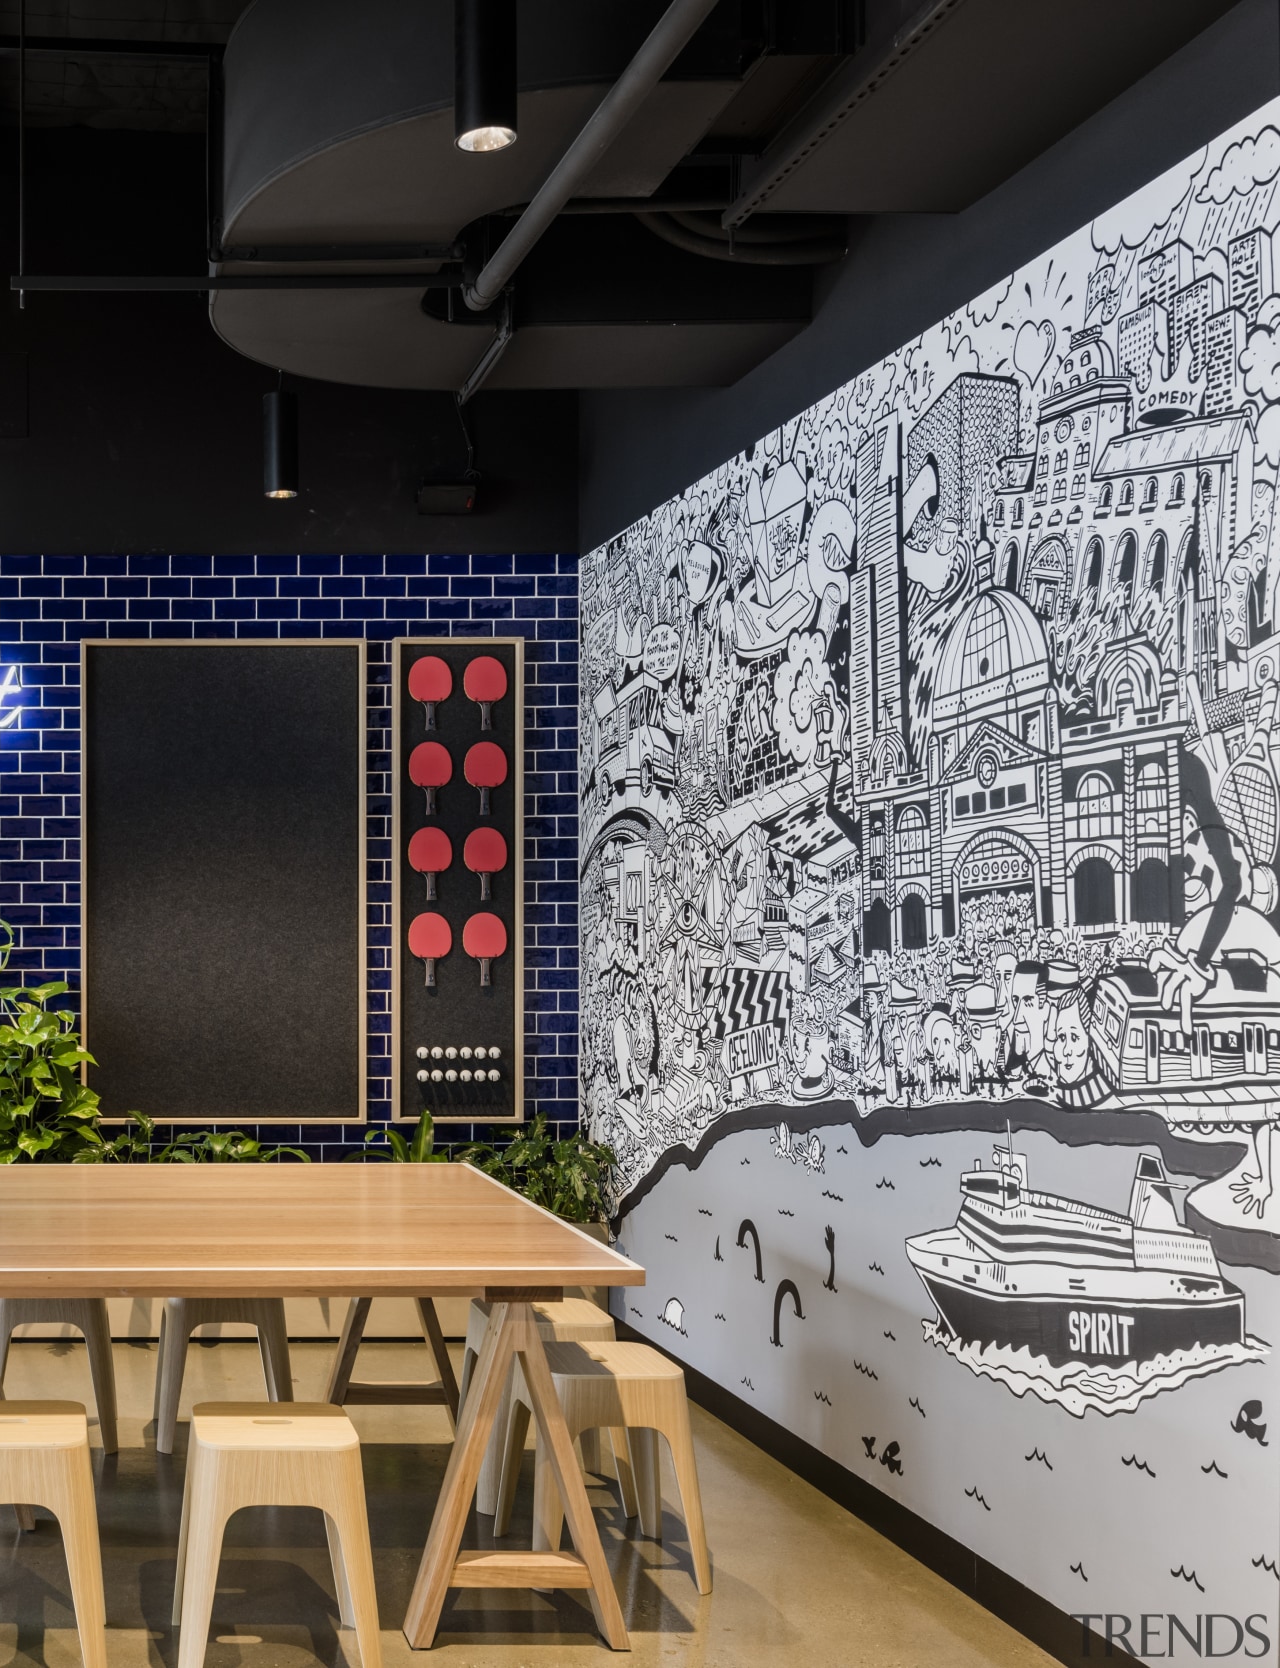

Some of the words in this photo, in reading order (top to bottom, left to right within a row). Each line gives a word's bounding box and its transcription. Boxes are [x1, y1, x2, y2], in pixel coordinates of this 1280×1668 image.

[1232, 235, 1256, 255] ARTS
[1176, 280, 1209, 308] SIREN
[1138, 390, 1198, 412] COMEDY
[691, 570, 701, 579] CUP
[661, 630, 669, 642] THE
[729, 1025, 773, 1074] GEELONG
[1068, 1310, 1135, 1356] SPIRIT
